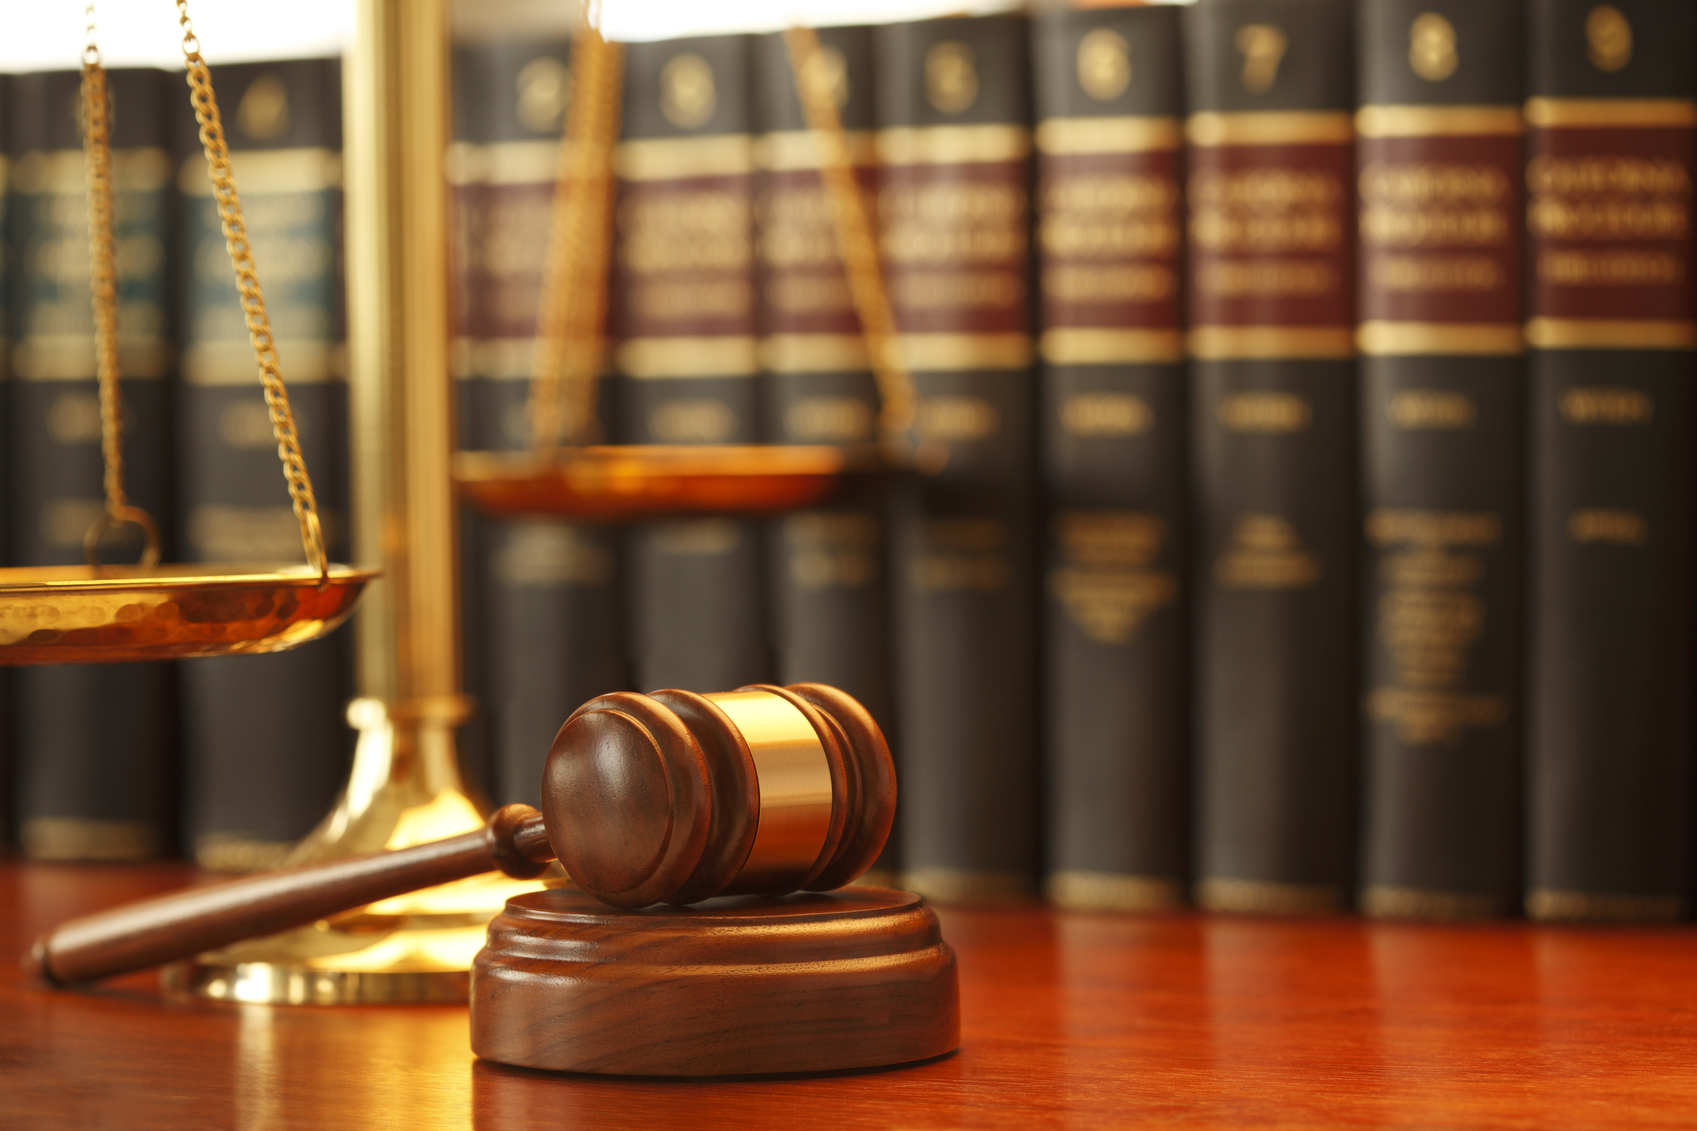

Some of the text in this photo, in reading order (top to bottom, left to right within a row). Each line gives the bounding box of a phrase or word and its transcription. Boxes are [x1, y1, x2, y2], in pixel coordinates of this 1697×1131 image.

[1077, 27, 1132, 101] 6
[1235, 23, 1288, 96] 7
[1409, 11, 1459, 82] 8
[1585, 5, 1633, 73] 9
